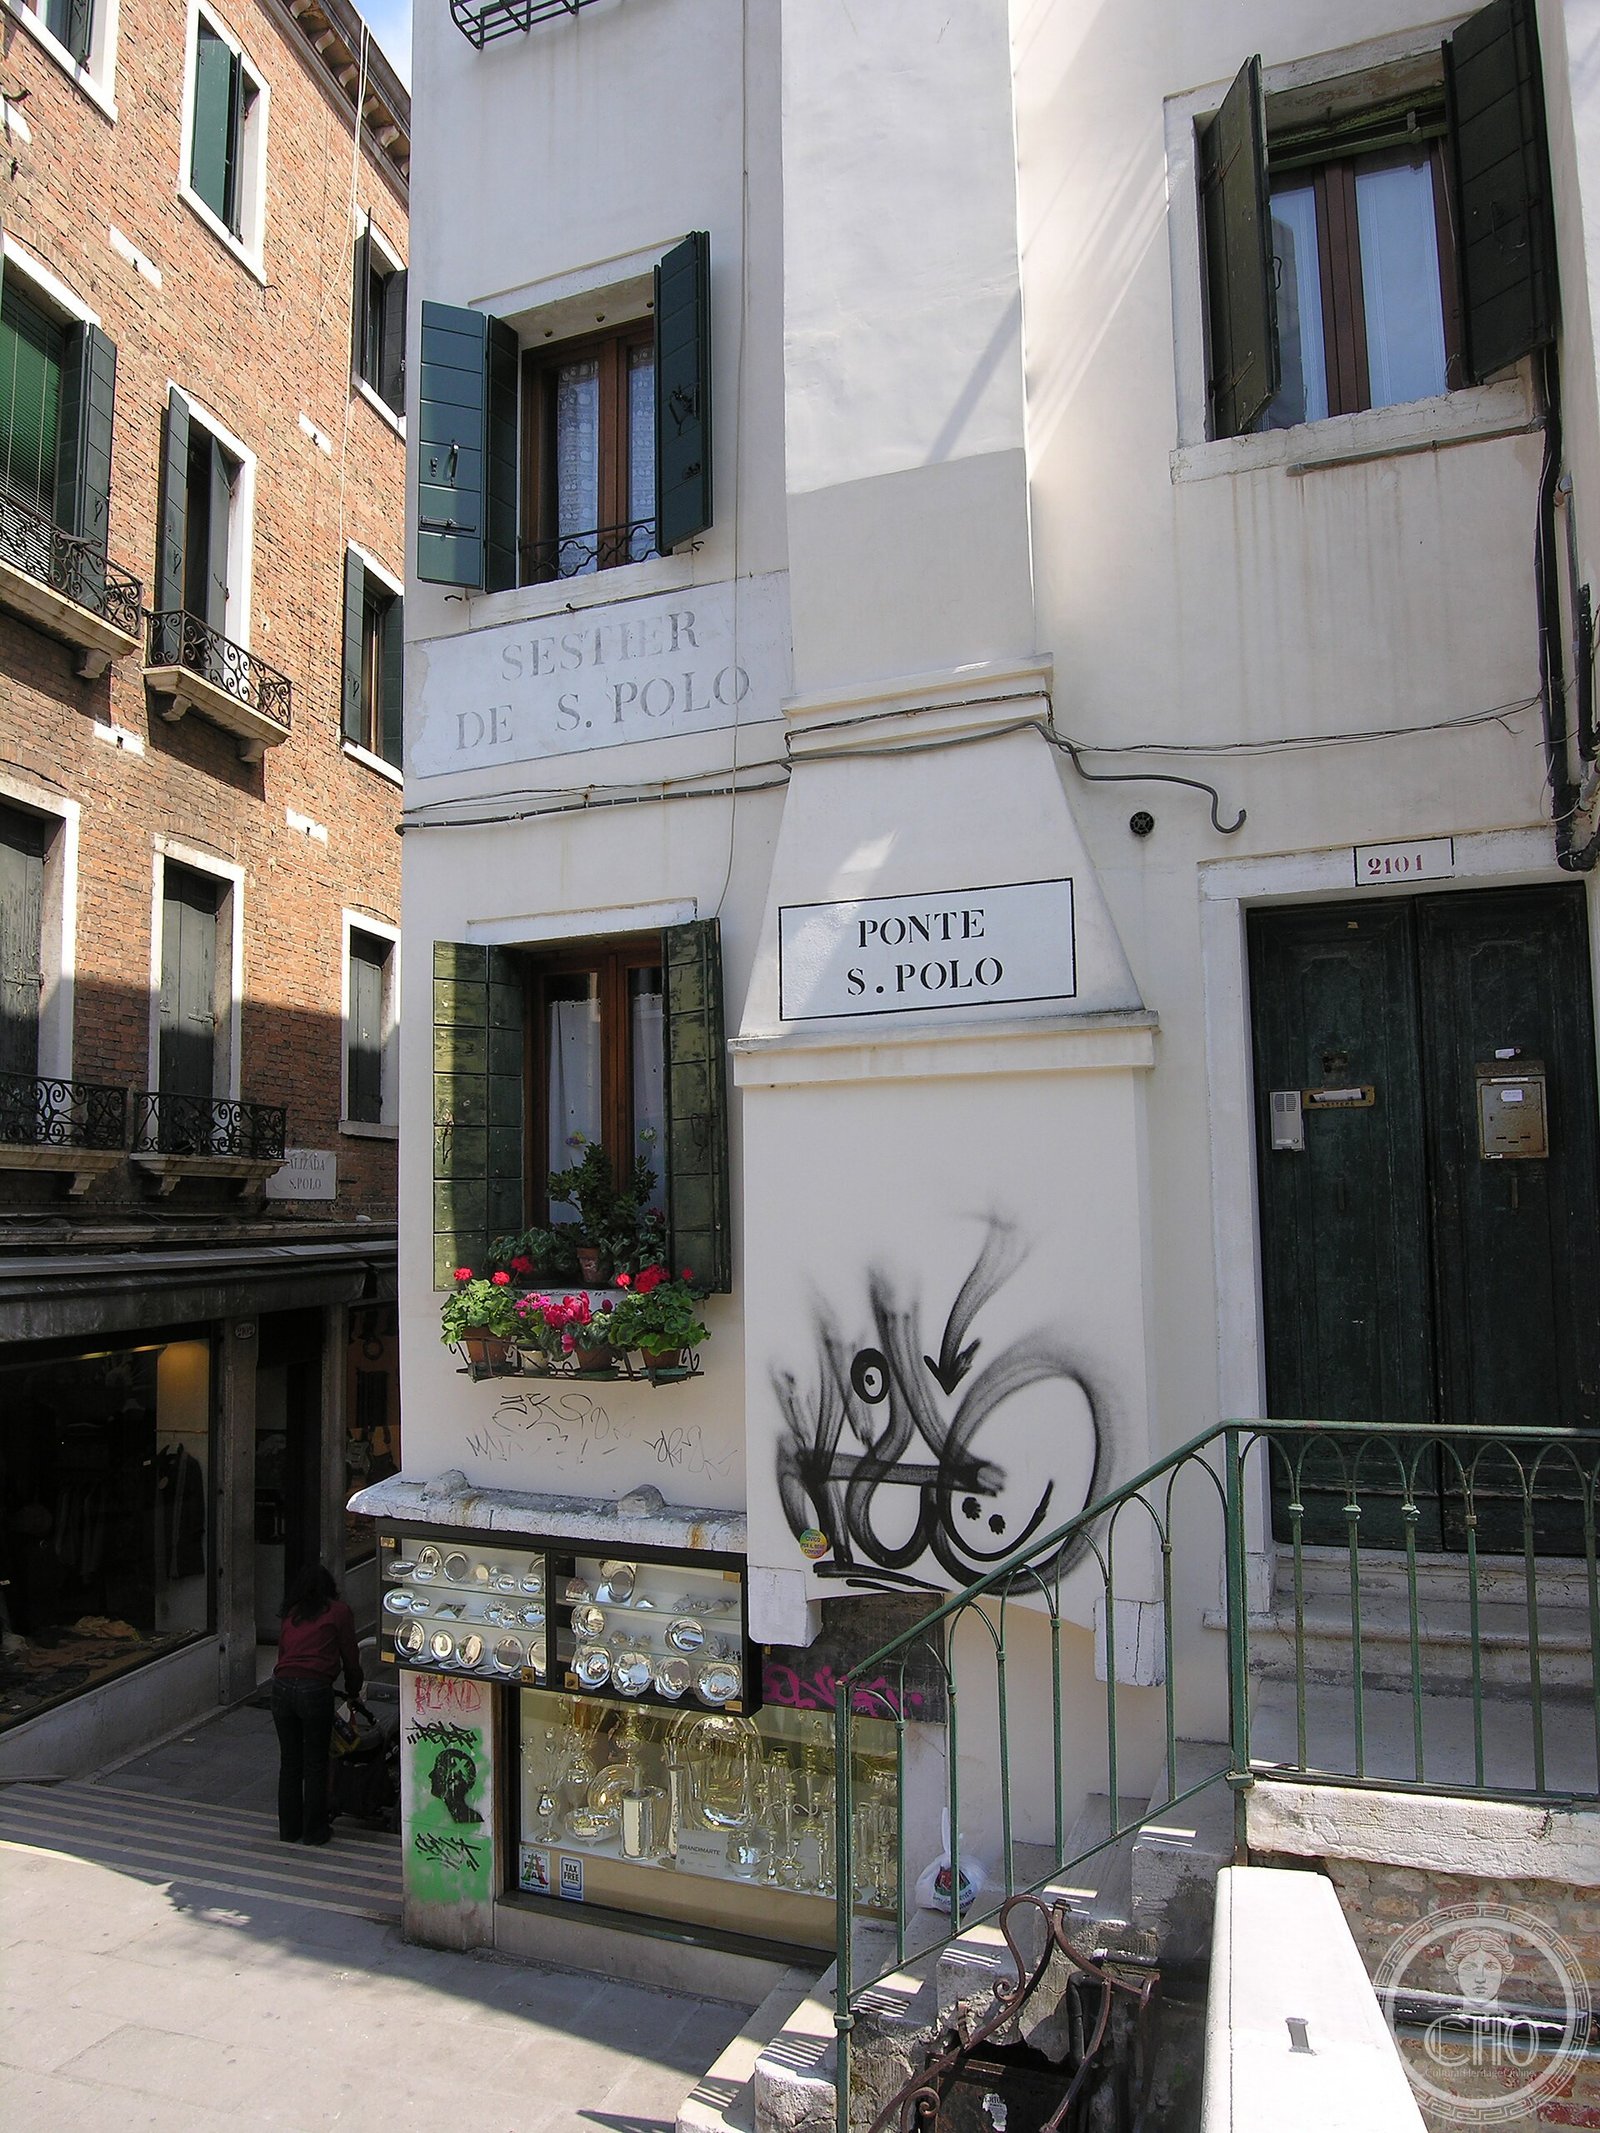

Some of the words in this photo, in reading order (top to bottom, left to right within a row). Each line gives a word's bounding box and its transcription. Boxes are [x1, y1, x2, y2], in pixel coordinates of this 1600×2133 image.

[501, 610, 700, 682] SESTIER
[456, 704, 513, 751] DE
[1367, 854, 1423, 876] 2101
[858, 908, 985, 949] PONTE
[563, 1871, 580, 1882] FREE
[564, 1863, 578, 1874] TAX
